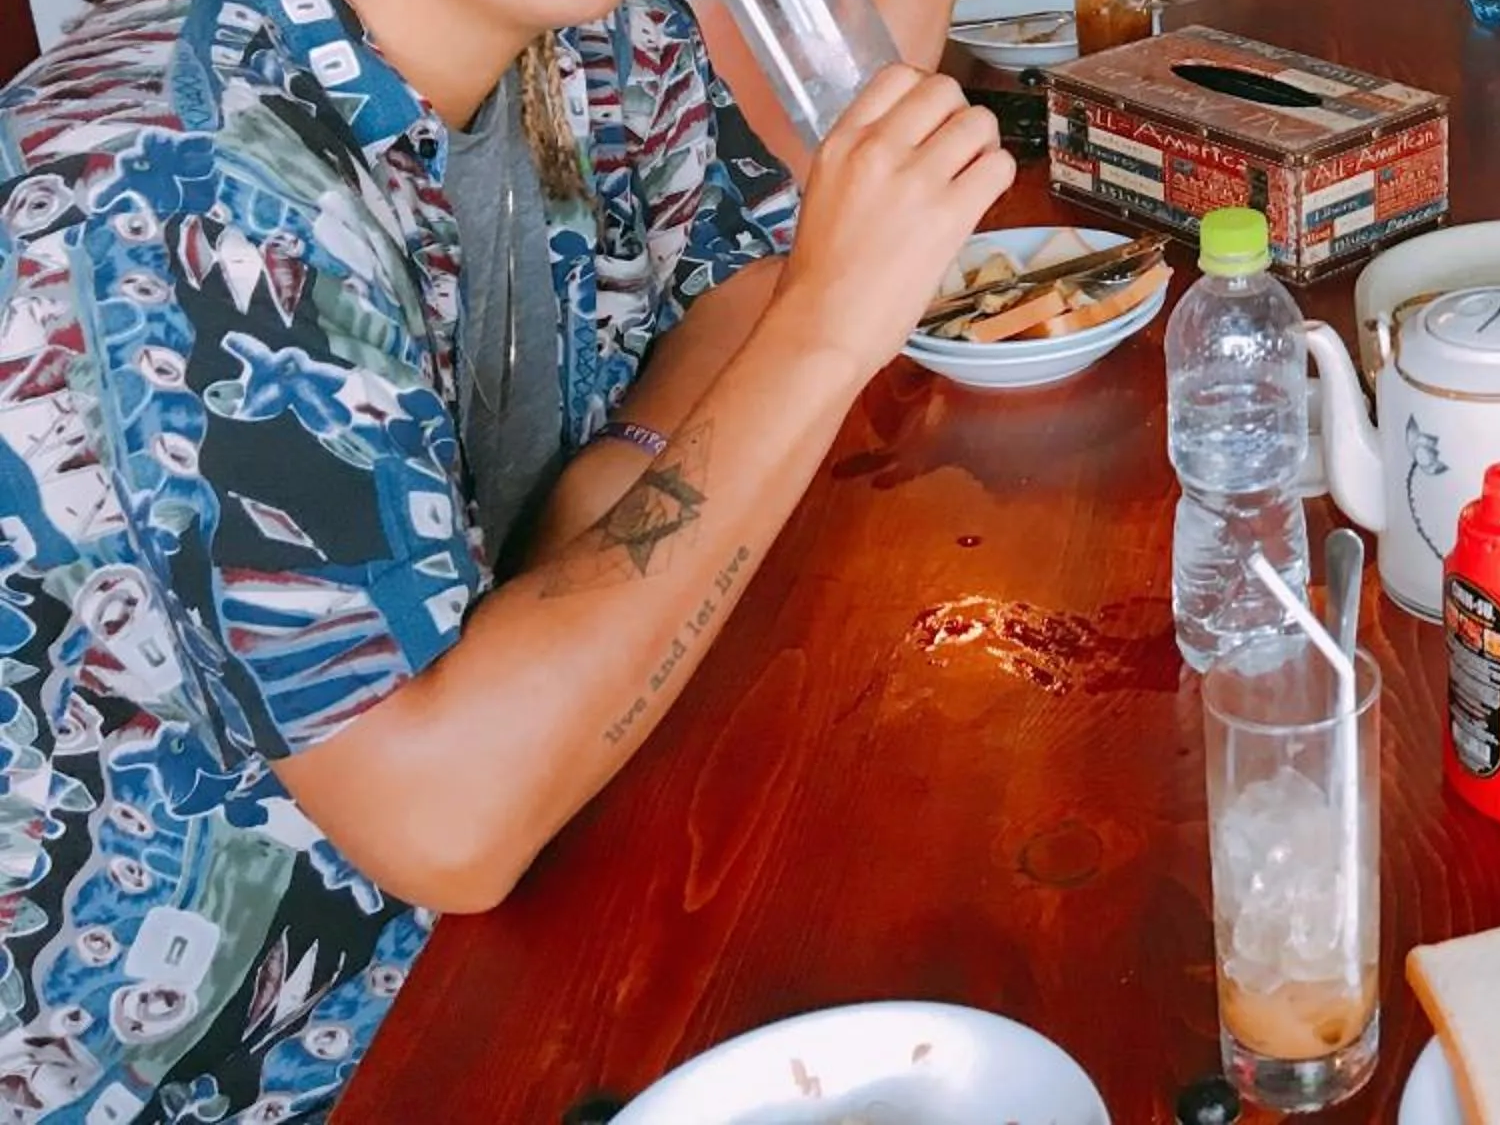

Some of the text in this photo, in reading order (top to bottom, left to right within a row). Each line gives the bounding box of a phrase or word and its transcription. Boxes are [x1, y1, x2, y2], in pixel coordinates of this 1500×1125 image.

[604, 543, 749, 745] live and let live
